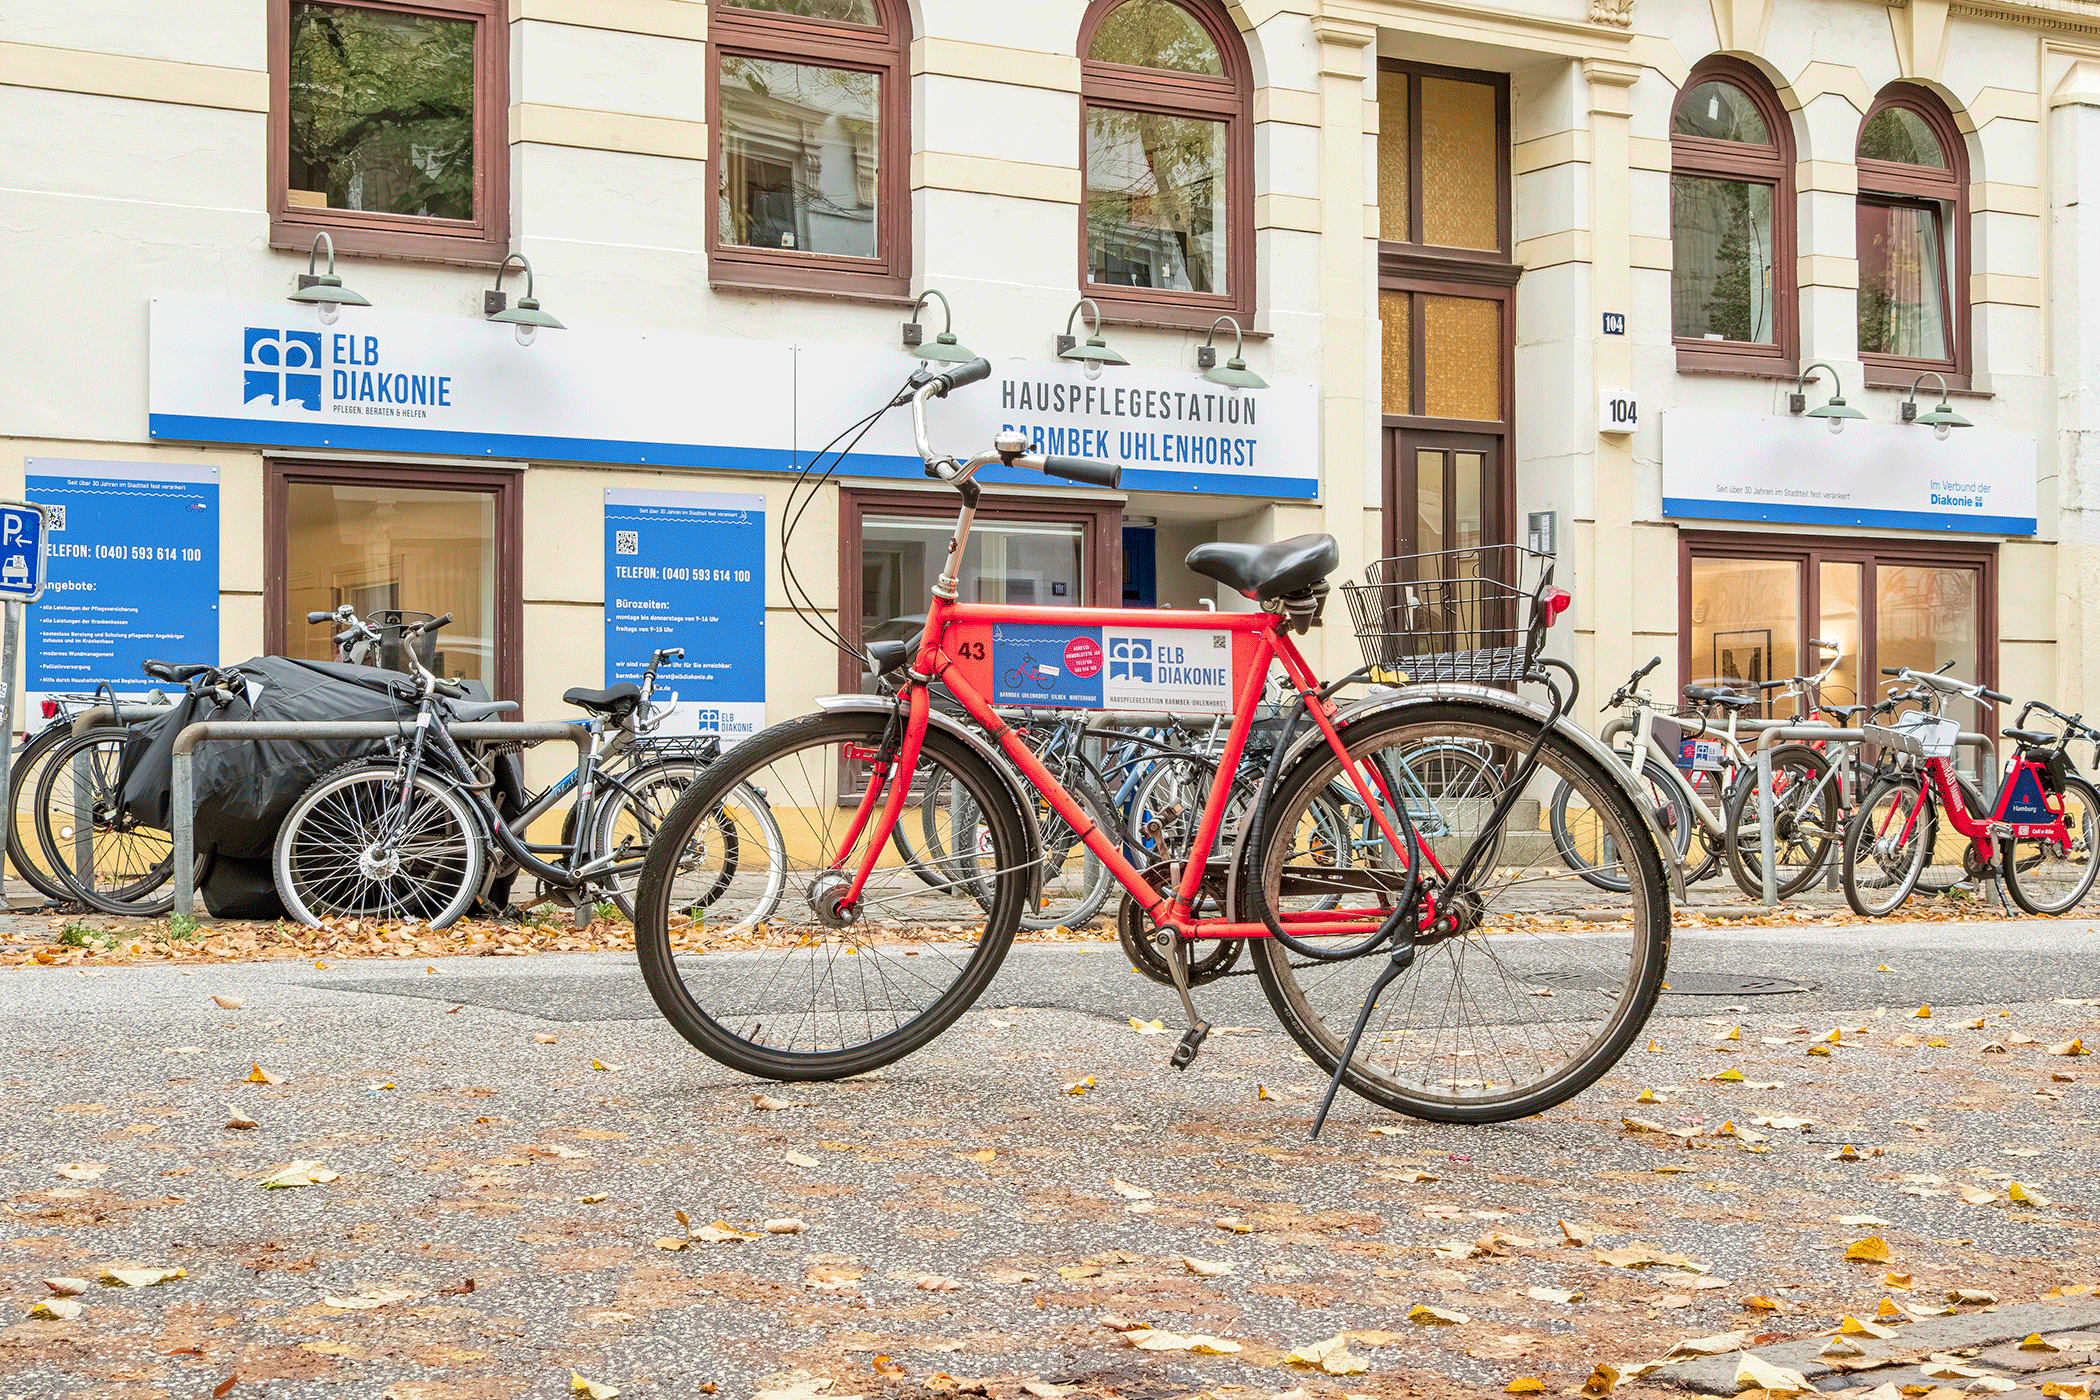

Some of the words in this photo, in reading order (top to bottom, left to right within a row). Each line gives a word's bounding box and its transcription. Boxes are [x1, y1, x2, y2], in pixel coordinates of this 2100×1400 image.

[1605, 315, 1623, 332] 104
[333, 334, 378, 366] ELB
[333, 369, 452, 407] DIAKONIE
[1002, 380, 1256, 425] HAUSPFLEGESTATION
[366, 406, 394, 416] BERATEN
[402, 409, 426, 418] HELFEN
[1610, 399, 1638, 424] 104
[1002, 424, 1110, 458] RMBEK
[1120, 430, 1257, 466] UHLENHORST
[1716, 484, 1728, 493] Seit
[1729, 485, 1743, 494] über
[1744, 486, 1752, 494] 30
[1753, 487, 1774, 496] Jahren
[1784, 488, 1808, 497] Stadtteil
[1810, 490, 1821, 498] fest
[1822, 491, 1850, 500] verankert
[1930, 480, 1940, 490] Im
[1942, 480, 1976, 492] Verbund
[1978, 483, 1991, 493] der
[1931, 494, 1972, 507] Diakonie
[3, 514, 22, 545] P
[47, 544, 91, 558] ELEFON:
[95, 544, 127, 560] (040)
[132, 547, 153, 560] 593
[156, 548, 177, 561] 614
[182, 549, 201, 561] 100
[616, 566, 659, 579] TELEFON:
[663, 567, 689, 581] (040)
[692, 568, 710, 581] 593
[713, 570, 730, 581] 614
[734, 570, 750, 582] 100
[616, 599, 670, 609] Bürozeiten:
[958, 642, 985, 660] 43
[1158, 646, 1184, 664] ELB
[1158, 666, 1226, 686] DIAKONIE
[1109, 696, 1164, 704] HAUSPFLEGESTATION
[722, 713, 734, 722] ELB
[722, 723, 753, 733] DIAKONIE
